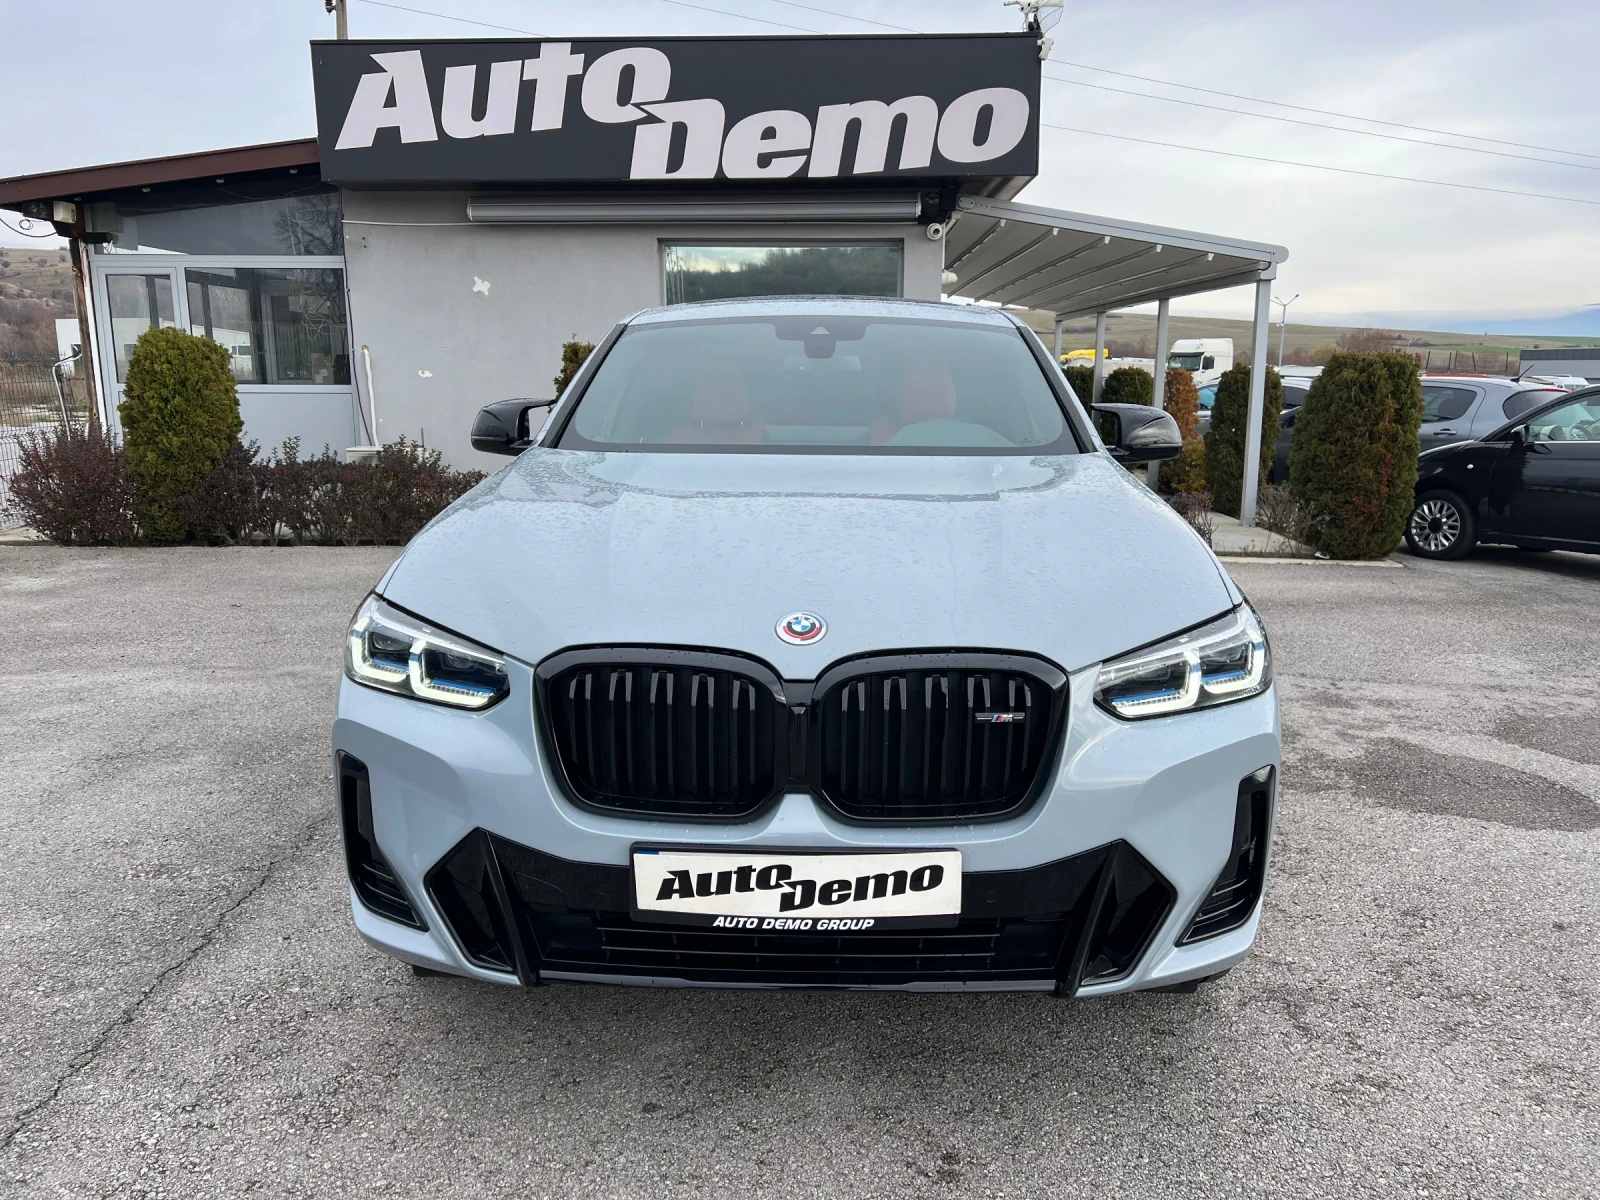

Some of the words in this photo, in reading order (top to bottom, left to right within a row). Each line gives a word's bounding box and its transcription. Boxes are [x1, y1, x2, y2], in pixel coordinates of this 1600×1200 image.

[335, 43, 672, 151] Auto
[630, 87, 1030, 180] Demo
[656, 864, 793, 901] Auto
[779, 864, 944, 912] Demo
[713, 916, 758, 929] AUTO
[762, 918, 812, 930] DEMO
[816, 918, 875, 930] GROUP
